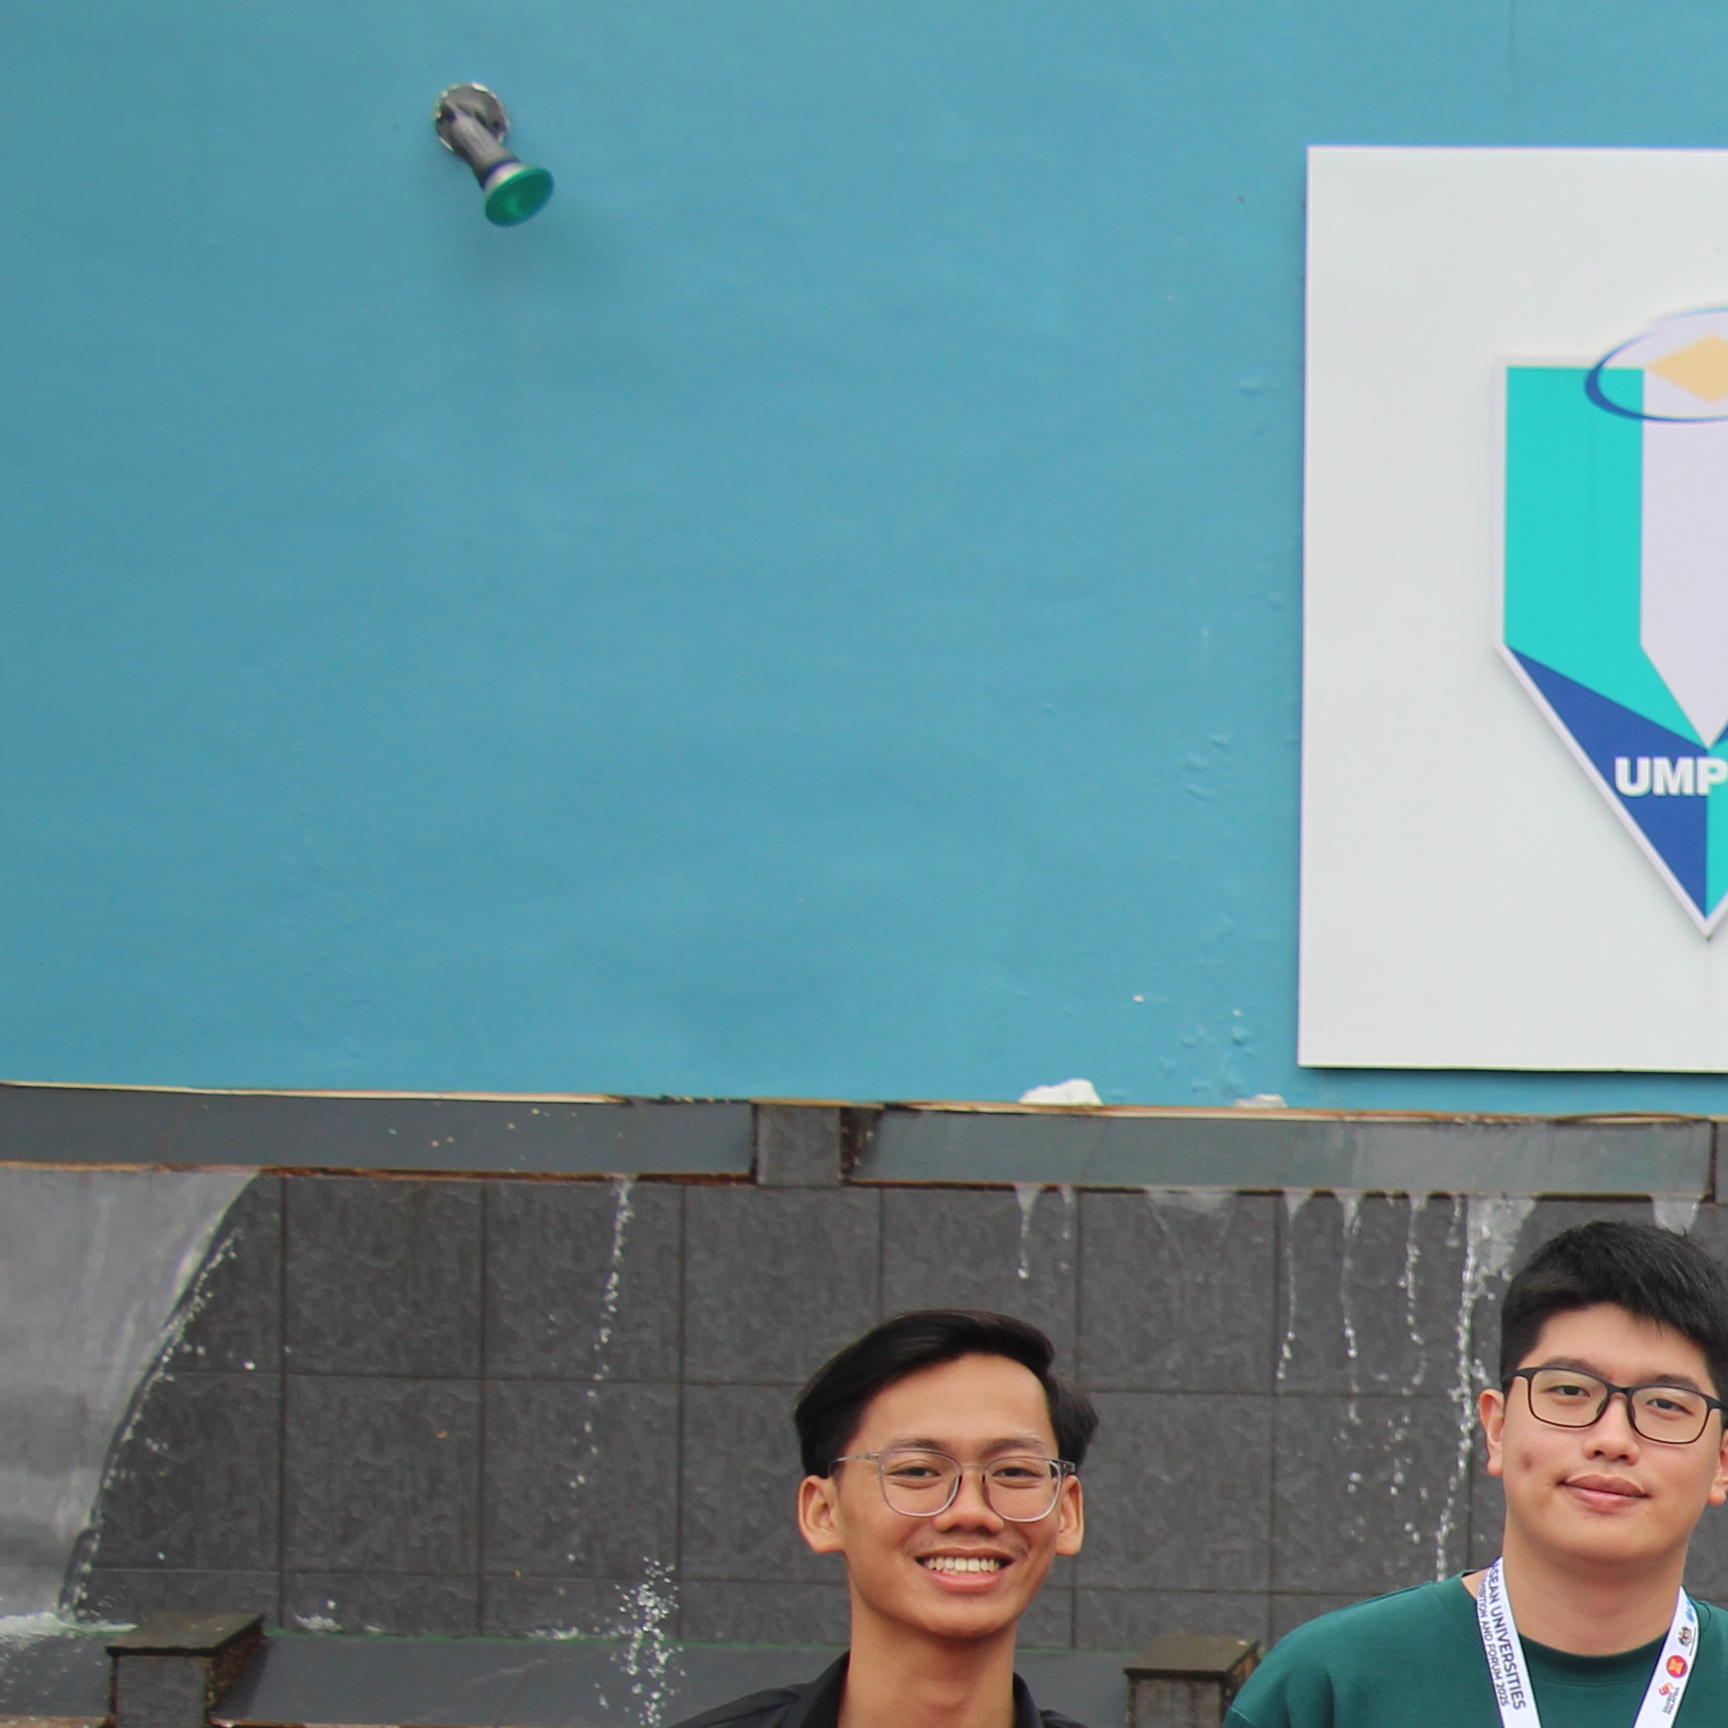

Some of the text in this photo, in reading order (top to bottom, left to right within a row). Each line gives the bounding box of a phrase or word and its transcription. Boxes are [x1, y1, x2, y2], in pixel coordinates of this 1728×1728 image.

[1480, 1619, 1494, 1642] AND
[1486, 1643, 1502, 1681] FORUM
[1490, 1606, 1527, 1711] UNIVERSITIES
[1496, 1681, 1511, 1707] 2025
